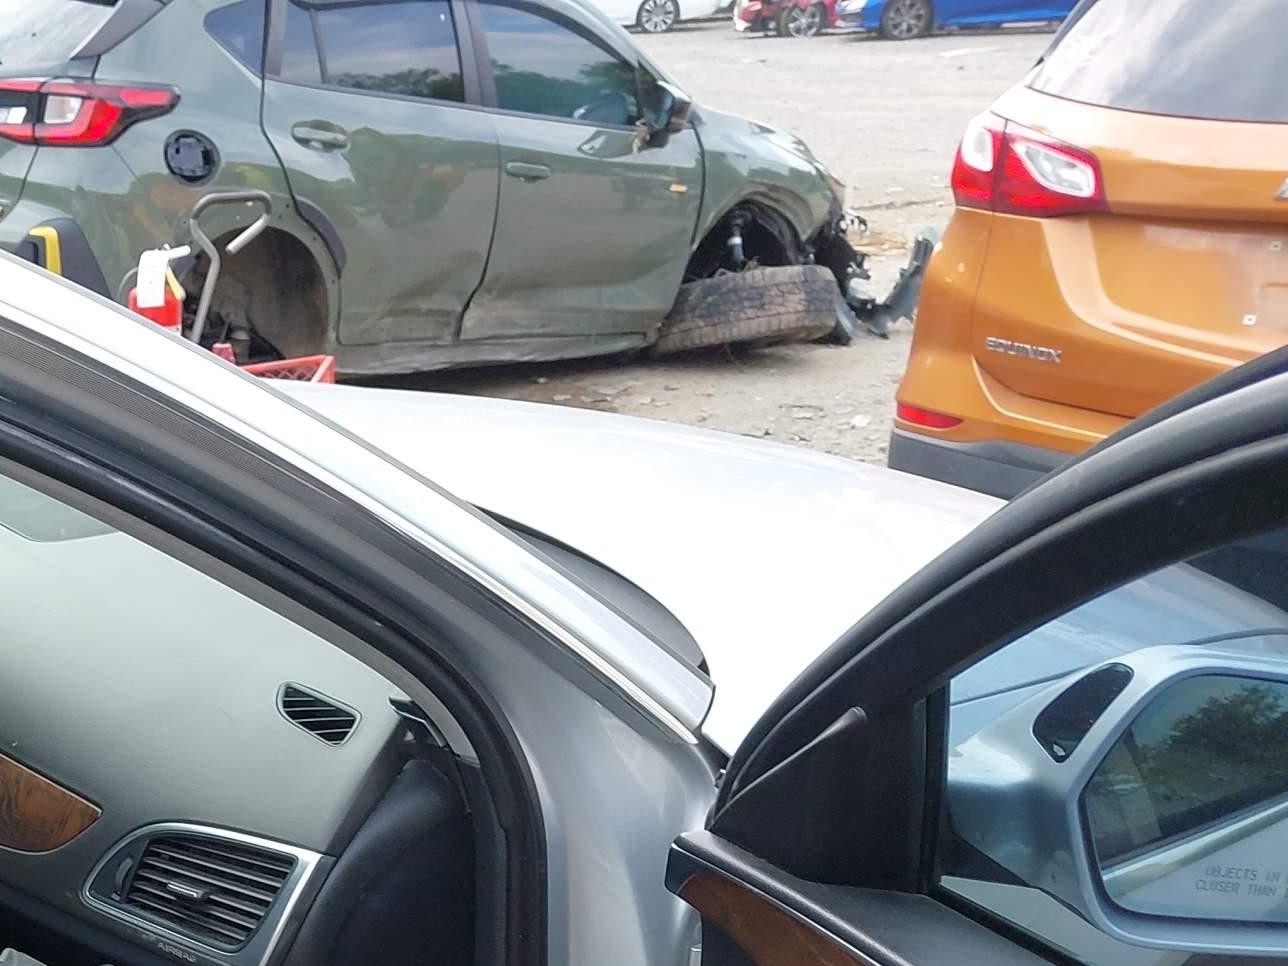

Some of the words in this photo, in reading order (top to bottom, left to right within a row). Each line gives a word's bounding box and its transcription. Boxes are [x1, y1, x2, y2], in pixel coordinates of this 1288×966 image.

[984, 336, 1063, 364] EQUINOX
[1205, 864, 1258, 881] OBJECTS
[1265, 869, 1281, 883] IN
[1194, 878, 1240, 894] CLOSER
[1247, 882, 1278, 897] THAN
[157, 941, 197, 963] AIRBAG
